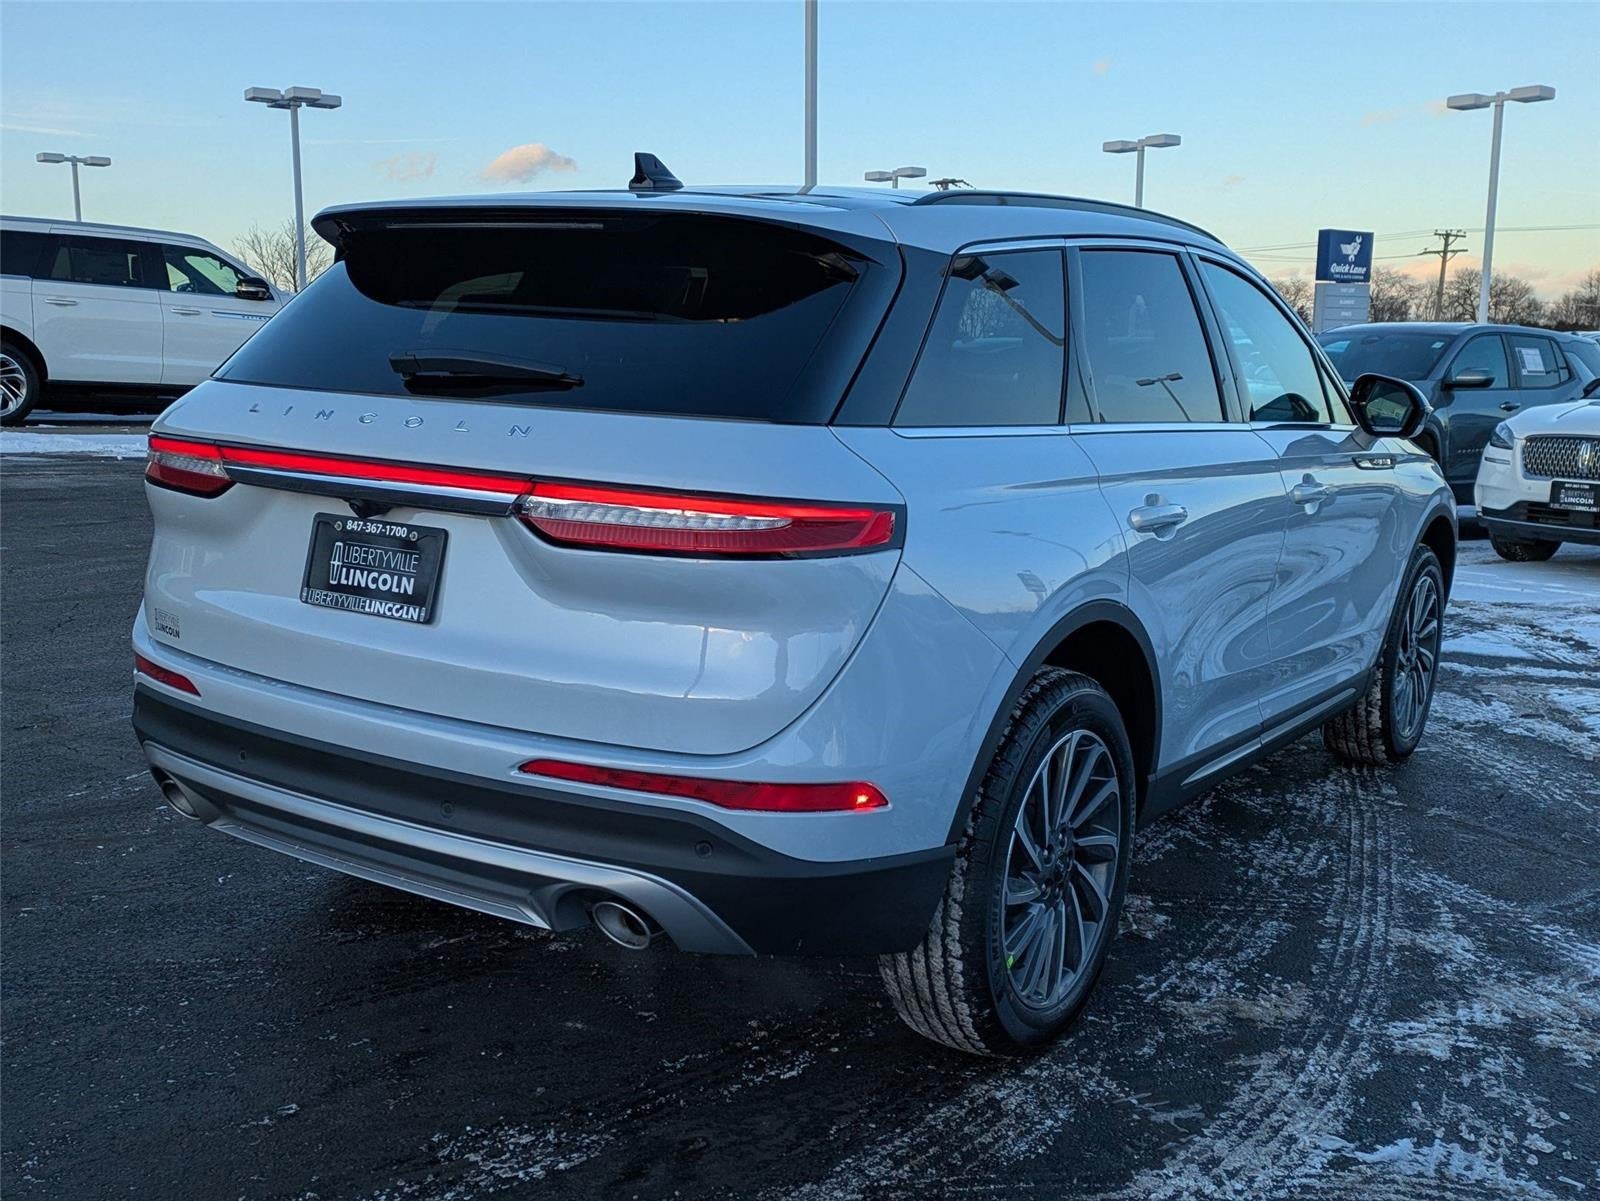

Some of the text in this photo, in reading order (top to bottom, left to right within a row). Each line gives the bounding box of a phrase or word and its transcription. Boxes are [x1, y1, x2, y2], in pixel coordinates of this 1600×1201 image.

[1330, 263, 1366, 273] Quick Lane
[249, 403, 532, 438] LINCOLN
[1564, 496, 1594, 505] LINCOLN
[346, 519, 408, 538] 847-367-1700
[344, 545, 419, 572] LIBERTYVILLE
[340, 567, 415, 595] LINCOLN
